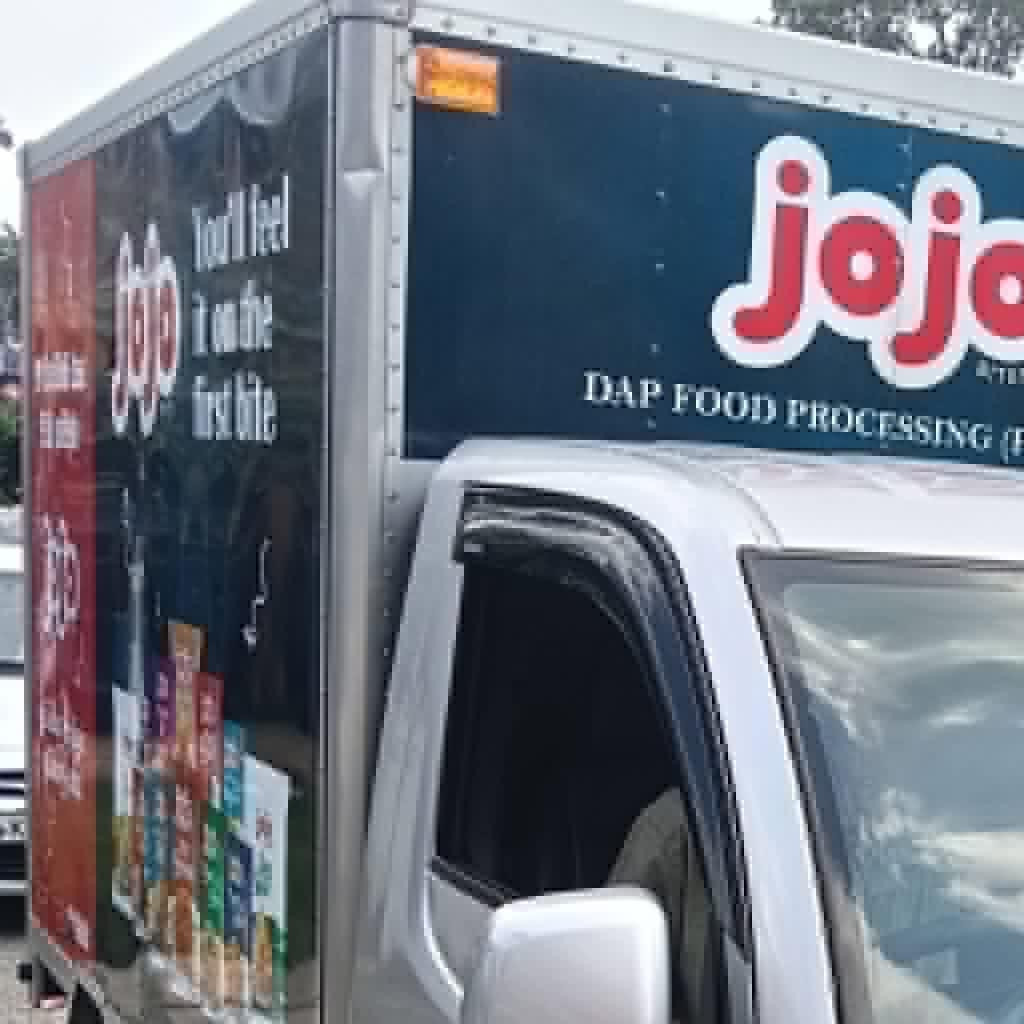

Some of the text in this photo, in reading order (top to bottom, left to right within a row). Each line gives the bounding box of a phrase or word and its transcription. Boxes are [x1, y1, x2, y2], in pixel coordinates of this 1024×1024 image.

[583, 368, 663, 410] DAP
[671, 382, 778, 426] FOOD
[783, 398, 993, 450] PROCESSING
